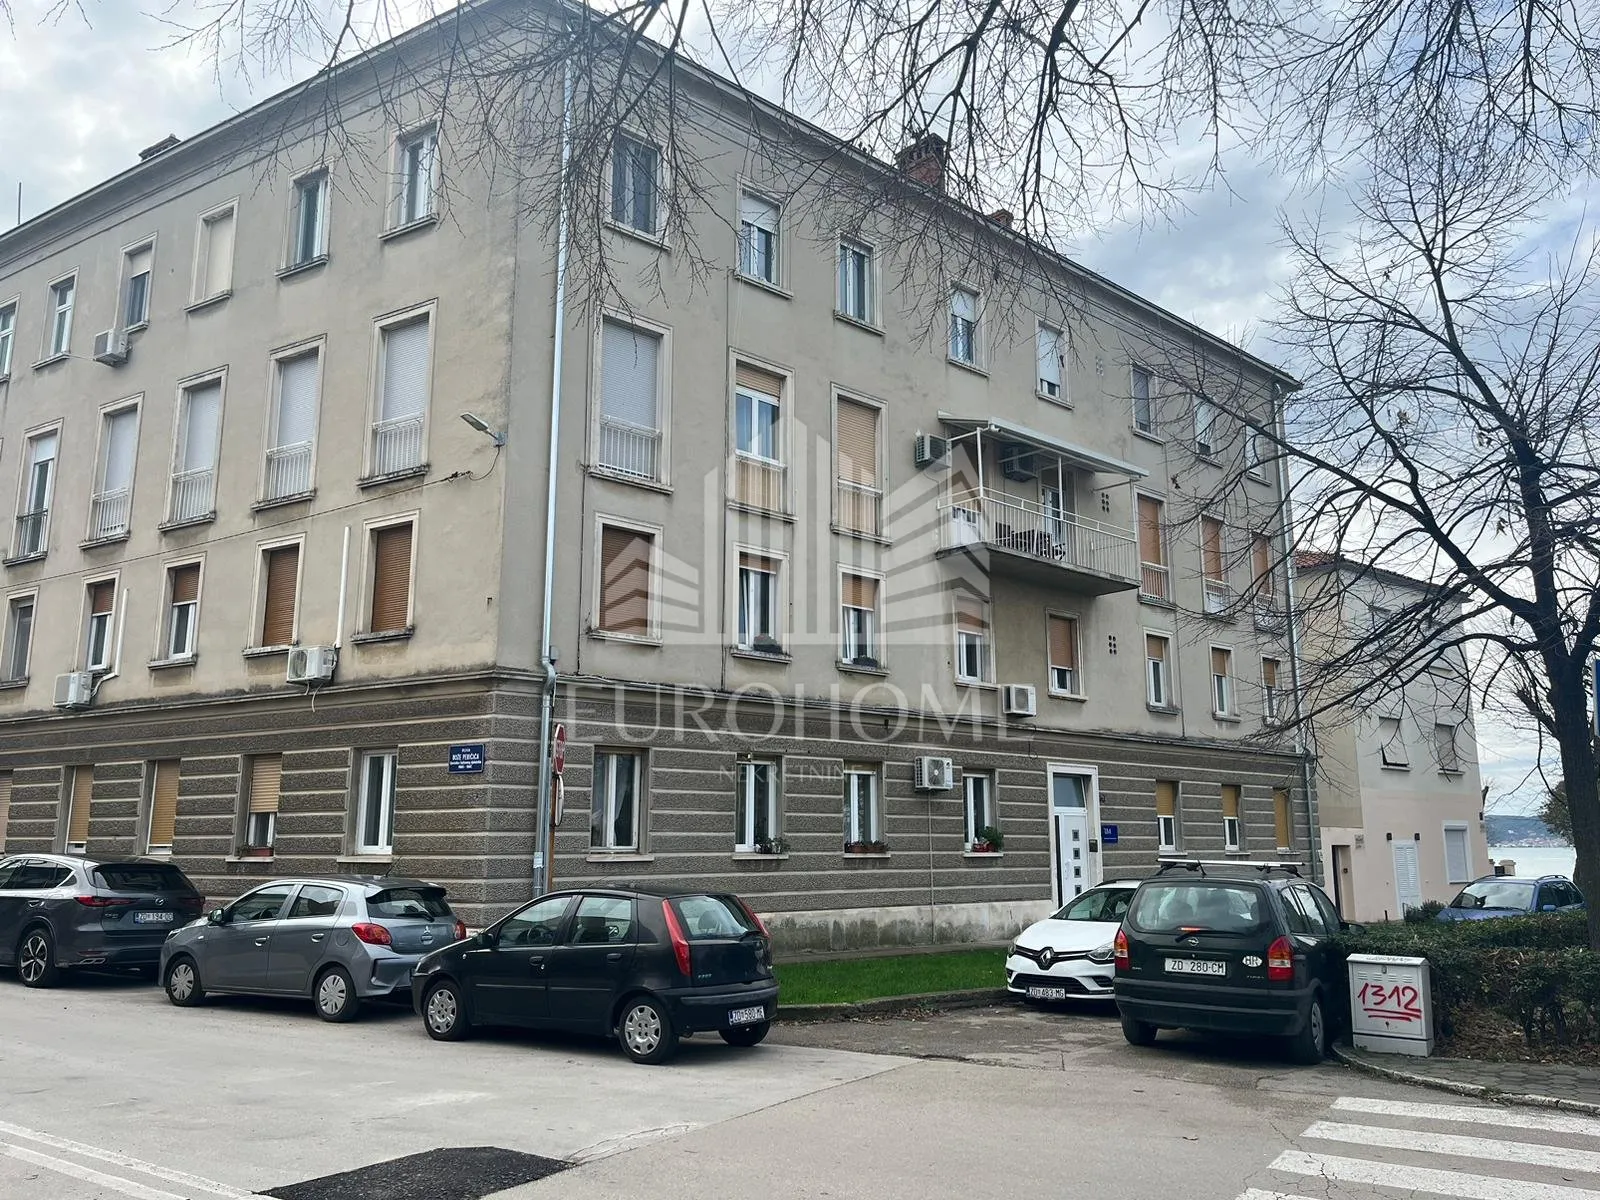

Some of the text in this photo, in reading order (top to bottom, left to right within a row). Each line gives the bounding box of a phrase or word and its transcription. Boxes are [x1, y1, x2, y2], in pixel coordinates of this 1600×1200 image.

[1171, 960, 1184, 971] ZD
[1244, 955, 1260, 966] HR
[1357, 982, 1422, 1014] 1312
